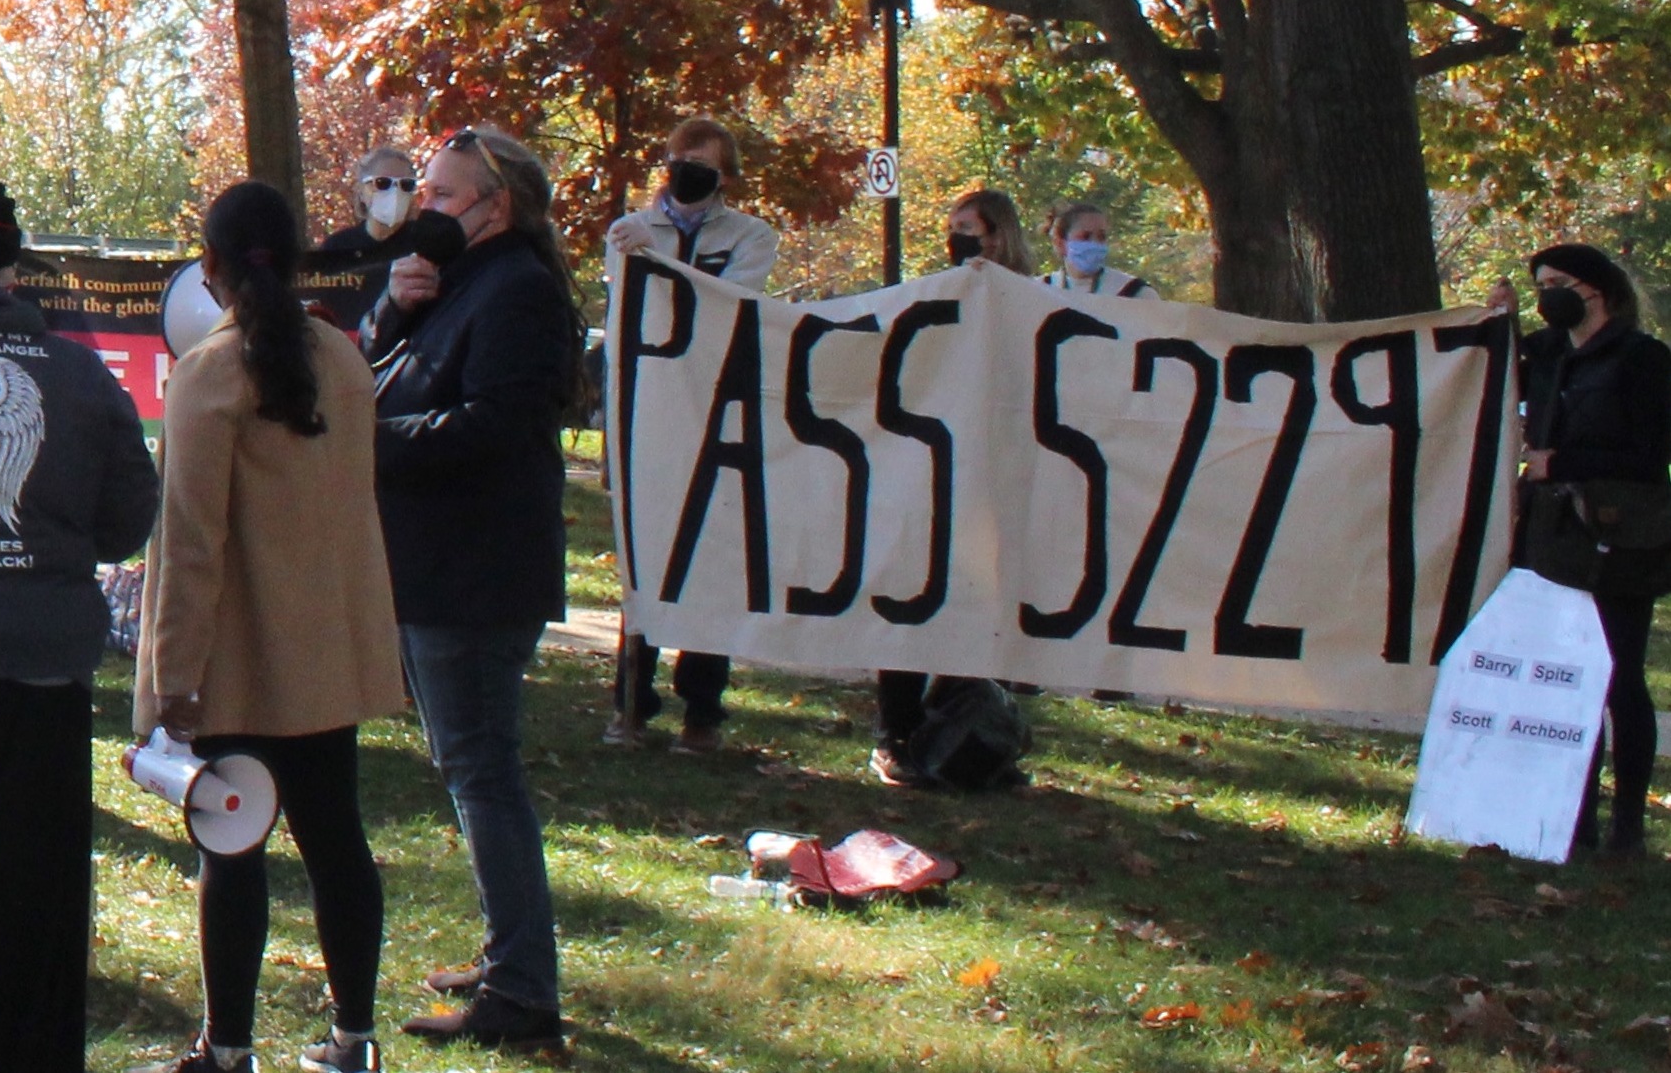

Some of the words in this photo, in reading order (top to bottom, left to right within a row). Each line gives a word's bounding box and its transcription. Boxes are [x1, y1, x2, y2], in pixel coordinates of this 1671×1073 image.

[297, 271, 365, 291] lidarity
[39, 295, 77, 311] with
[83, 296, 112, 313] the
[614, 253, 961, 626] PASS
[1018, 308, 1514, 666] S2297
[1473, 655, 1518, 676] Barry
[1533, 665, 1575, 683] Spitz
[1451, 710, 1492, 729] Scott
[1510, 720, 1583, 742] Archbold
